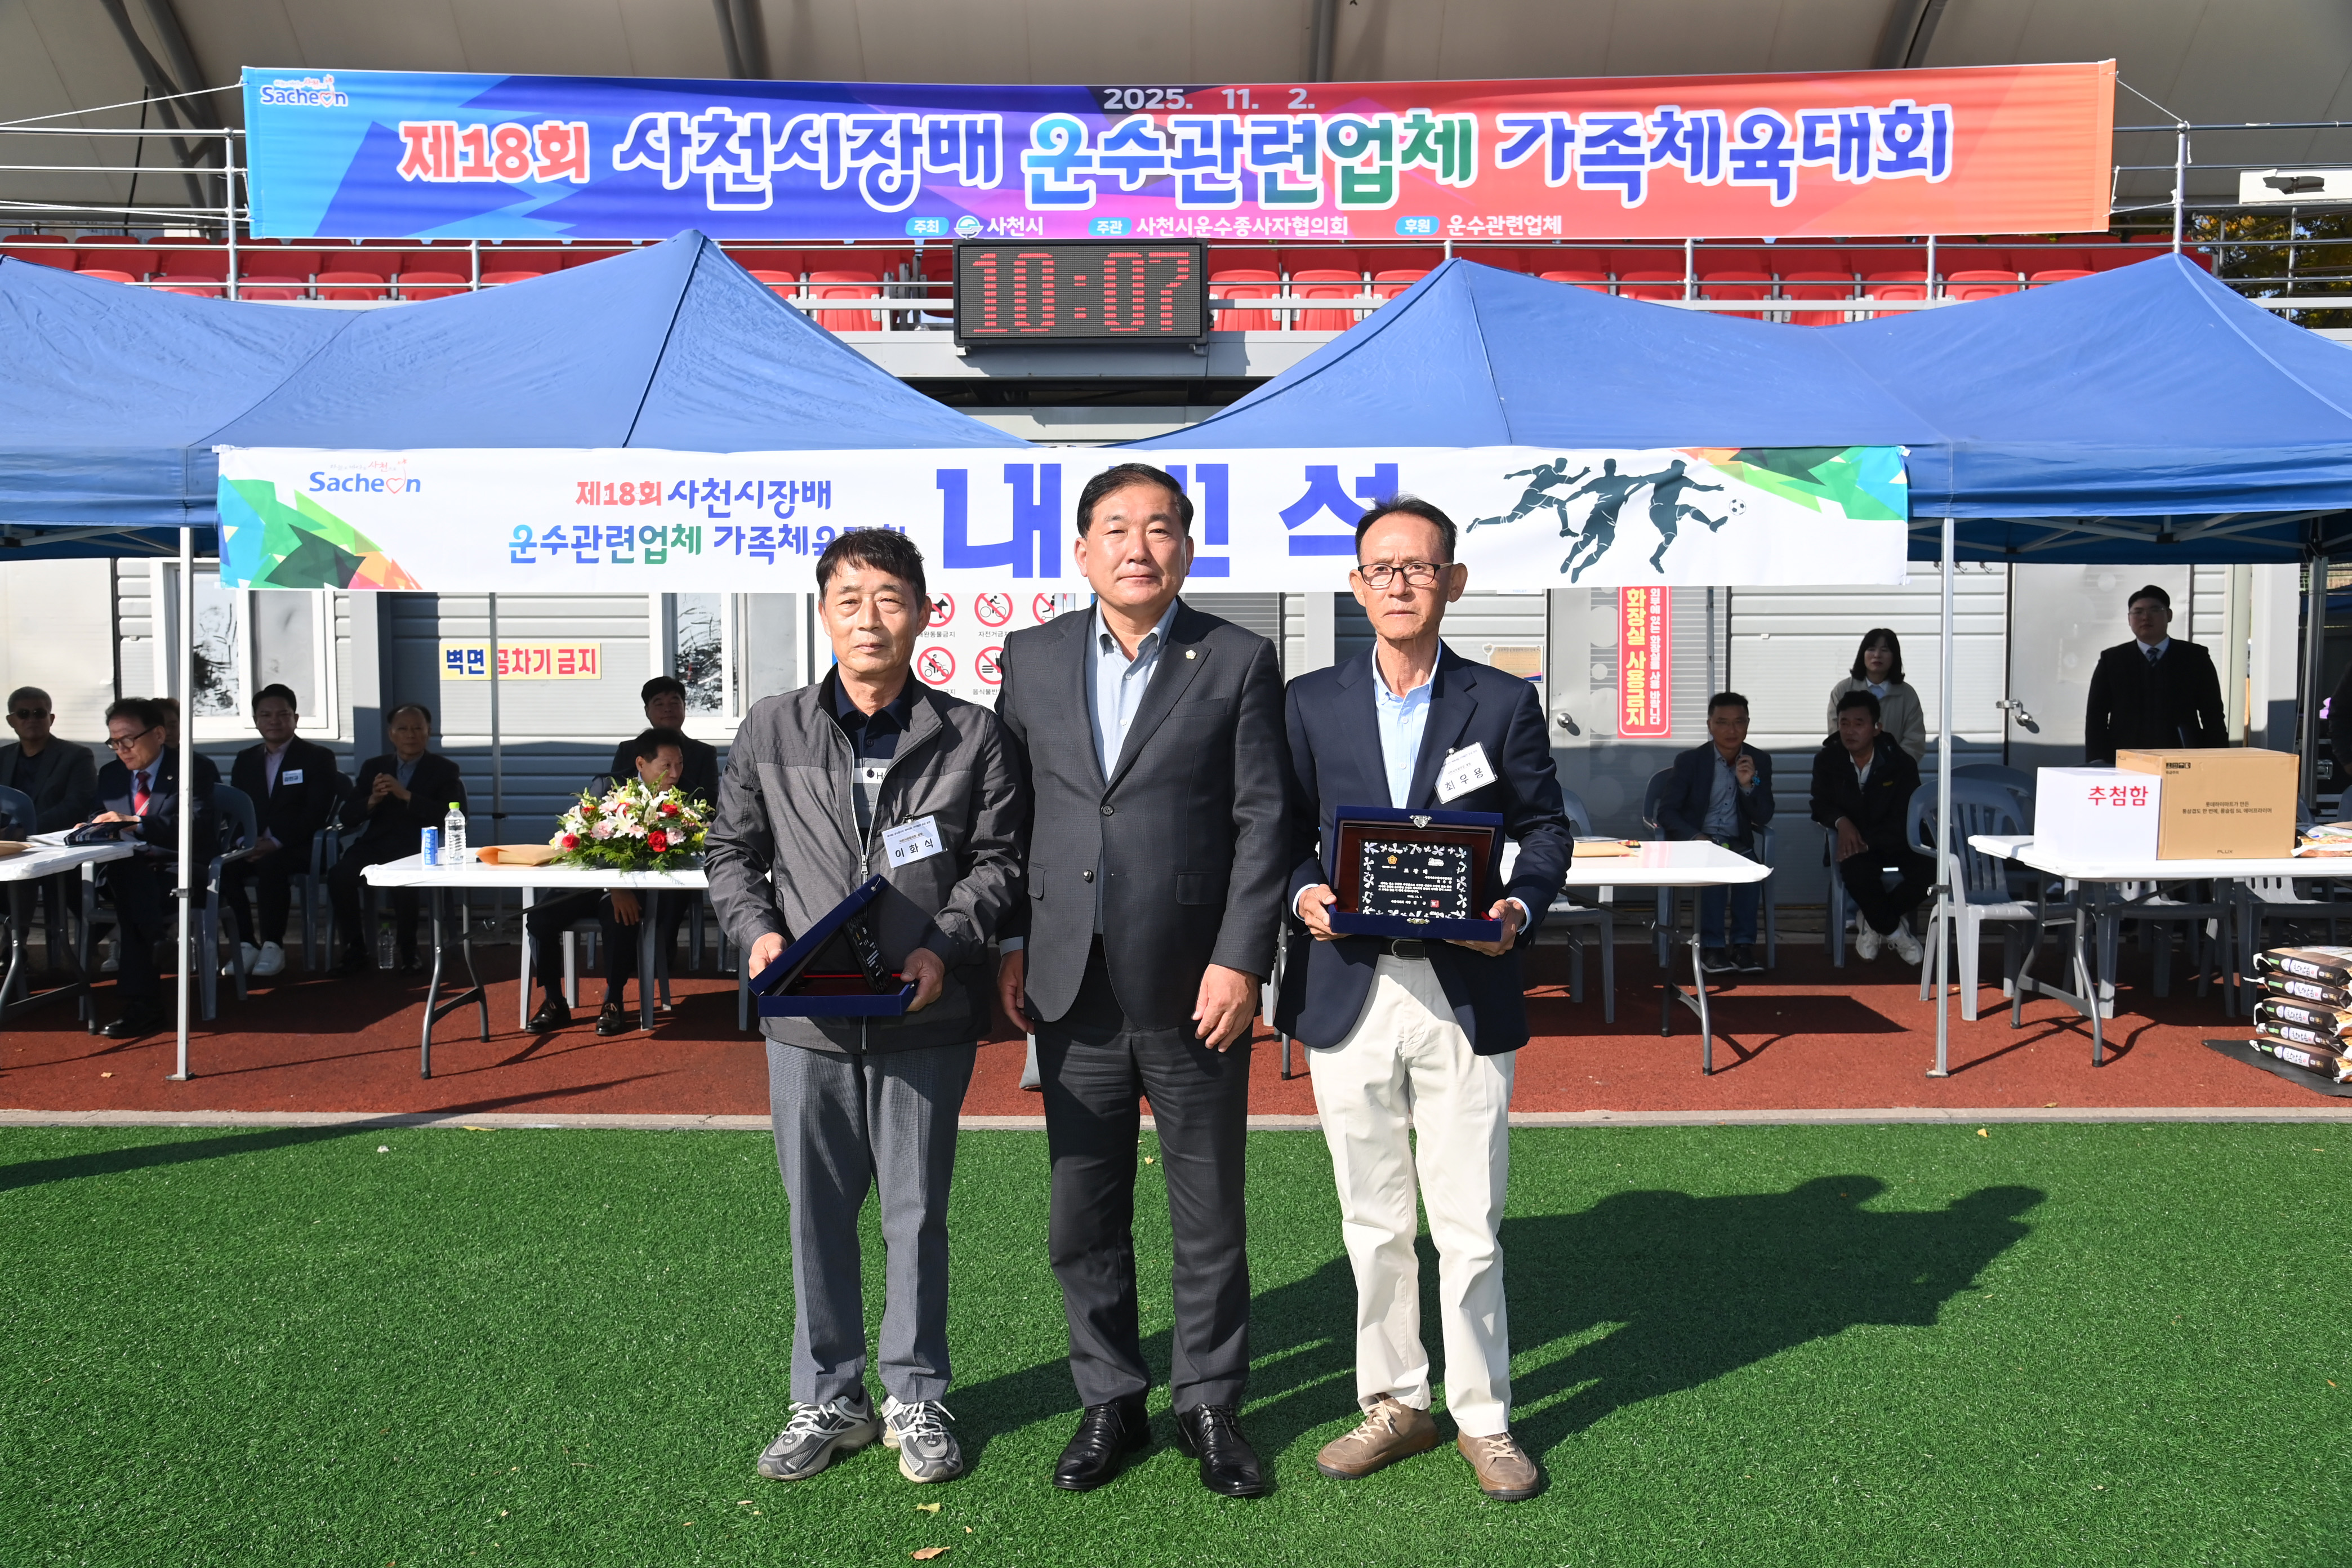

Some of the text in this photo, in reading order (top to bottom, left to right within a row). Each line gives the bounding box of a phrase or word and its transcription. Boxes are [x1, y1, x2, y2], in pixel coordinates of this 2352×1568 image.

[1104, 88, 1315, 110] 2025. 11. 2.
[398, 101, 1952, 211] 제18회 사천시장배 운수관련업체 가족체육대회
[912, 215, 1044, 237] 주최 사천시
[1093, 215, 1349, 237] 주관 사천시운수종사자협의회
[1404, 214, 1562, 236] 후원 운수관련업체
[973, 252, 1190, 333] 10:07
[309, 471, 421, 494] Sacheon
[576, 477, 831, 519] 제18회 사천시장배
[509, 523, 906, 565] 운수관련업체 가족체육
[447, 648, 596, 675] 벽면 공차기 금지
[1625, 588, 1647, 726] 화장실 사용금지
[1650, 587, 1661, 725] 외부에 있는 화장실을 사용 바랍니다
[2087, 786, 2149, 807] 추첨함
